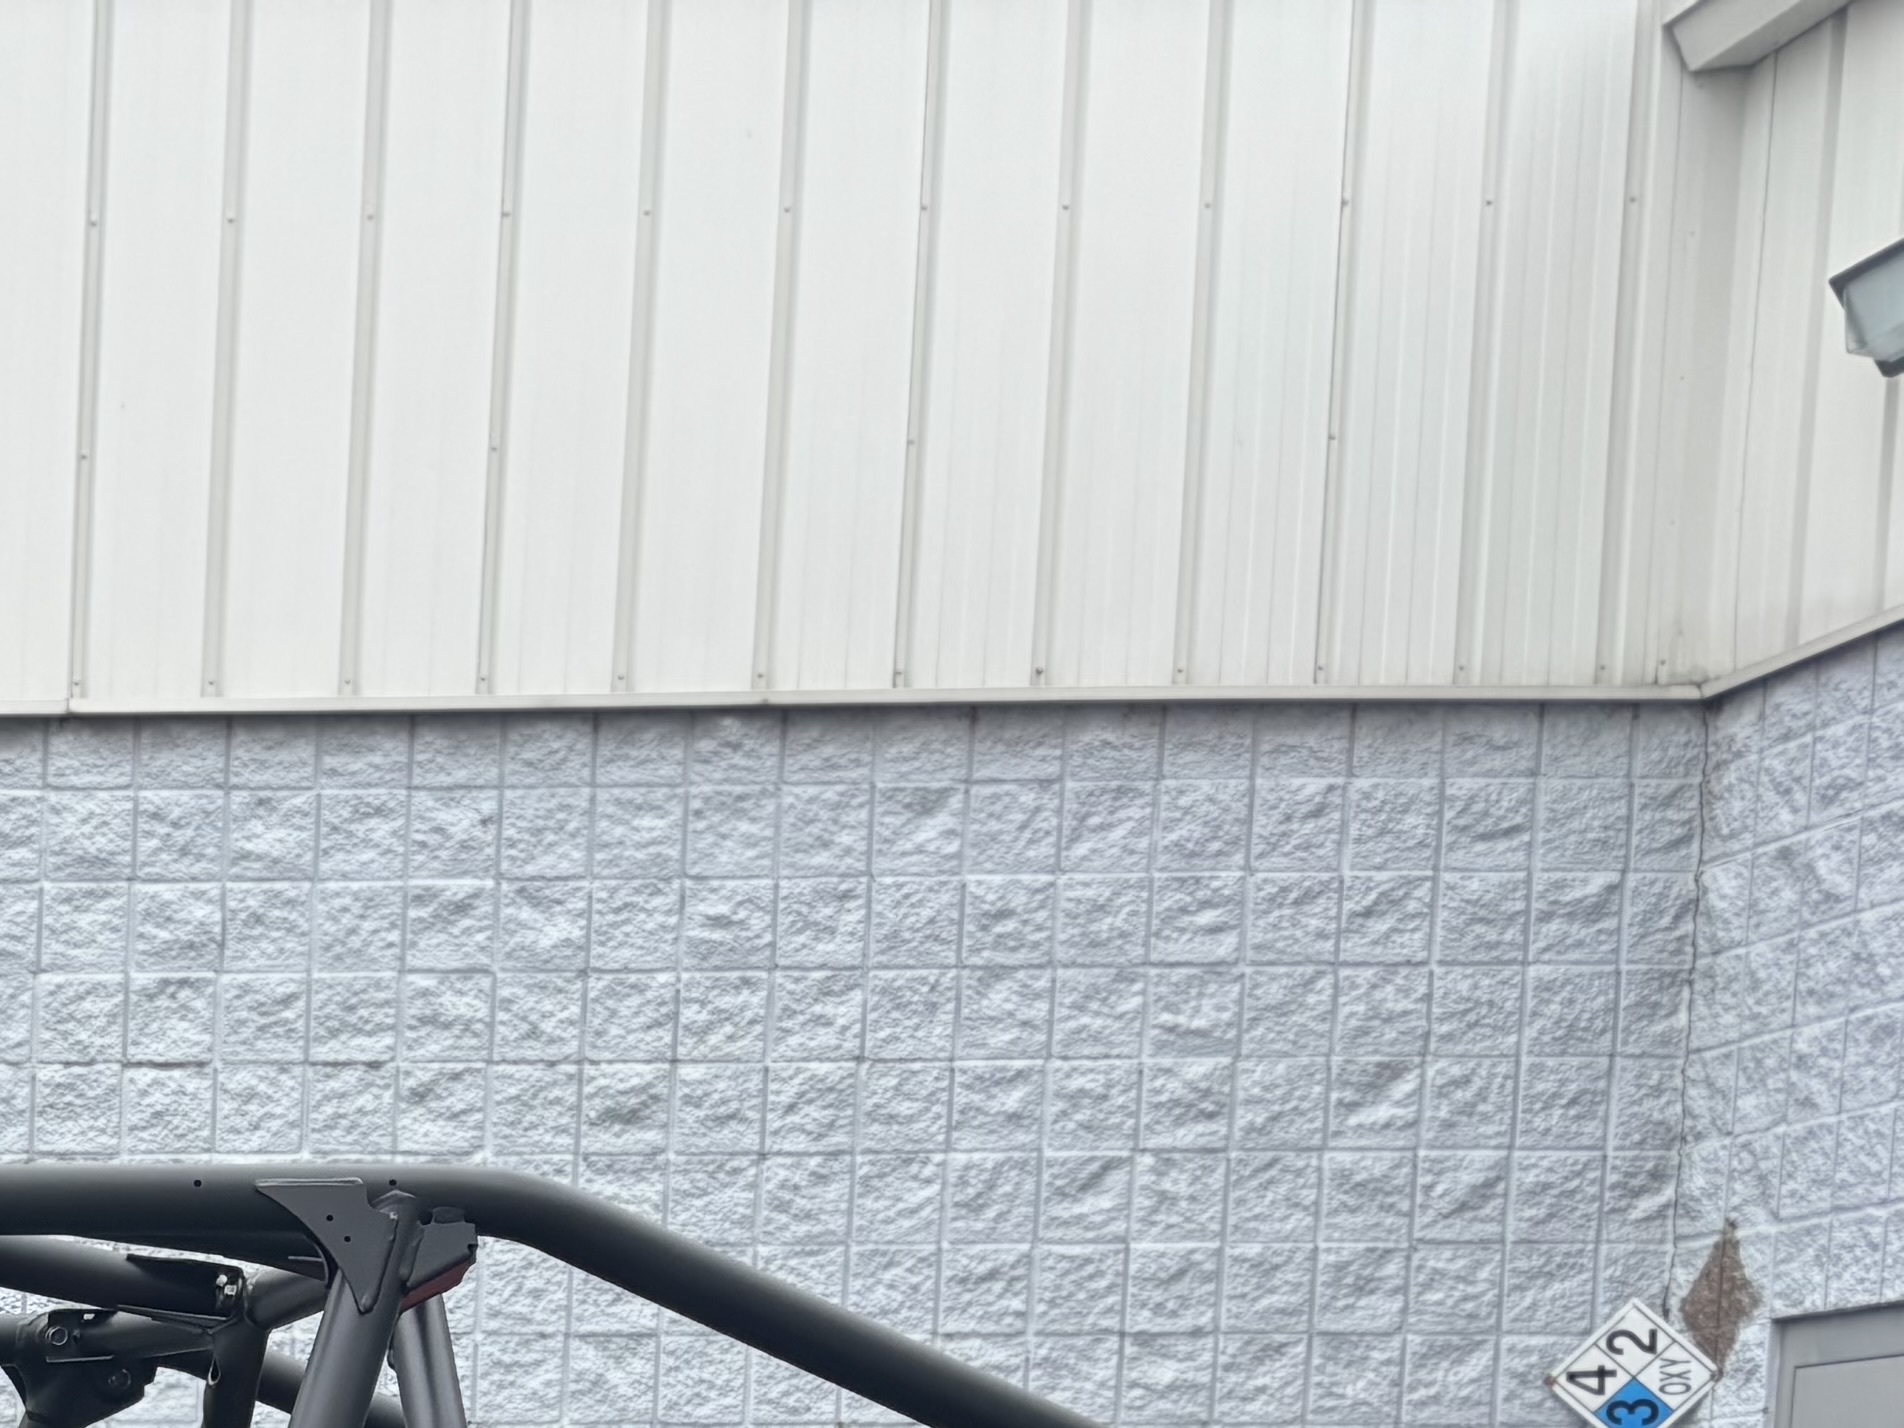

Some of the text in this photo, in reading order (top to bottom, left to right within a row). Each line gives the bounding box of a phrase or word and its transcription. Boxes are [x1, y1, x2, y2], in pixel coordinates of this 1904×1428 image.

[1606, 1328, 1658, 1356] 2
[1566, 1365, 1617, 1396] 4
[1659, 1357, 1692, 1396] OXY
[1606, 1398, 1659, 1426] 3
